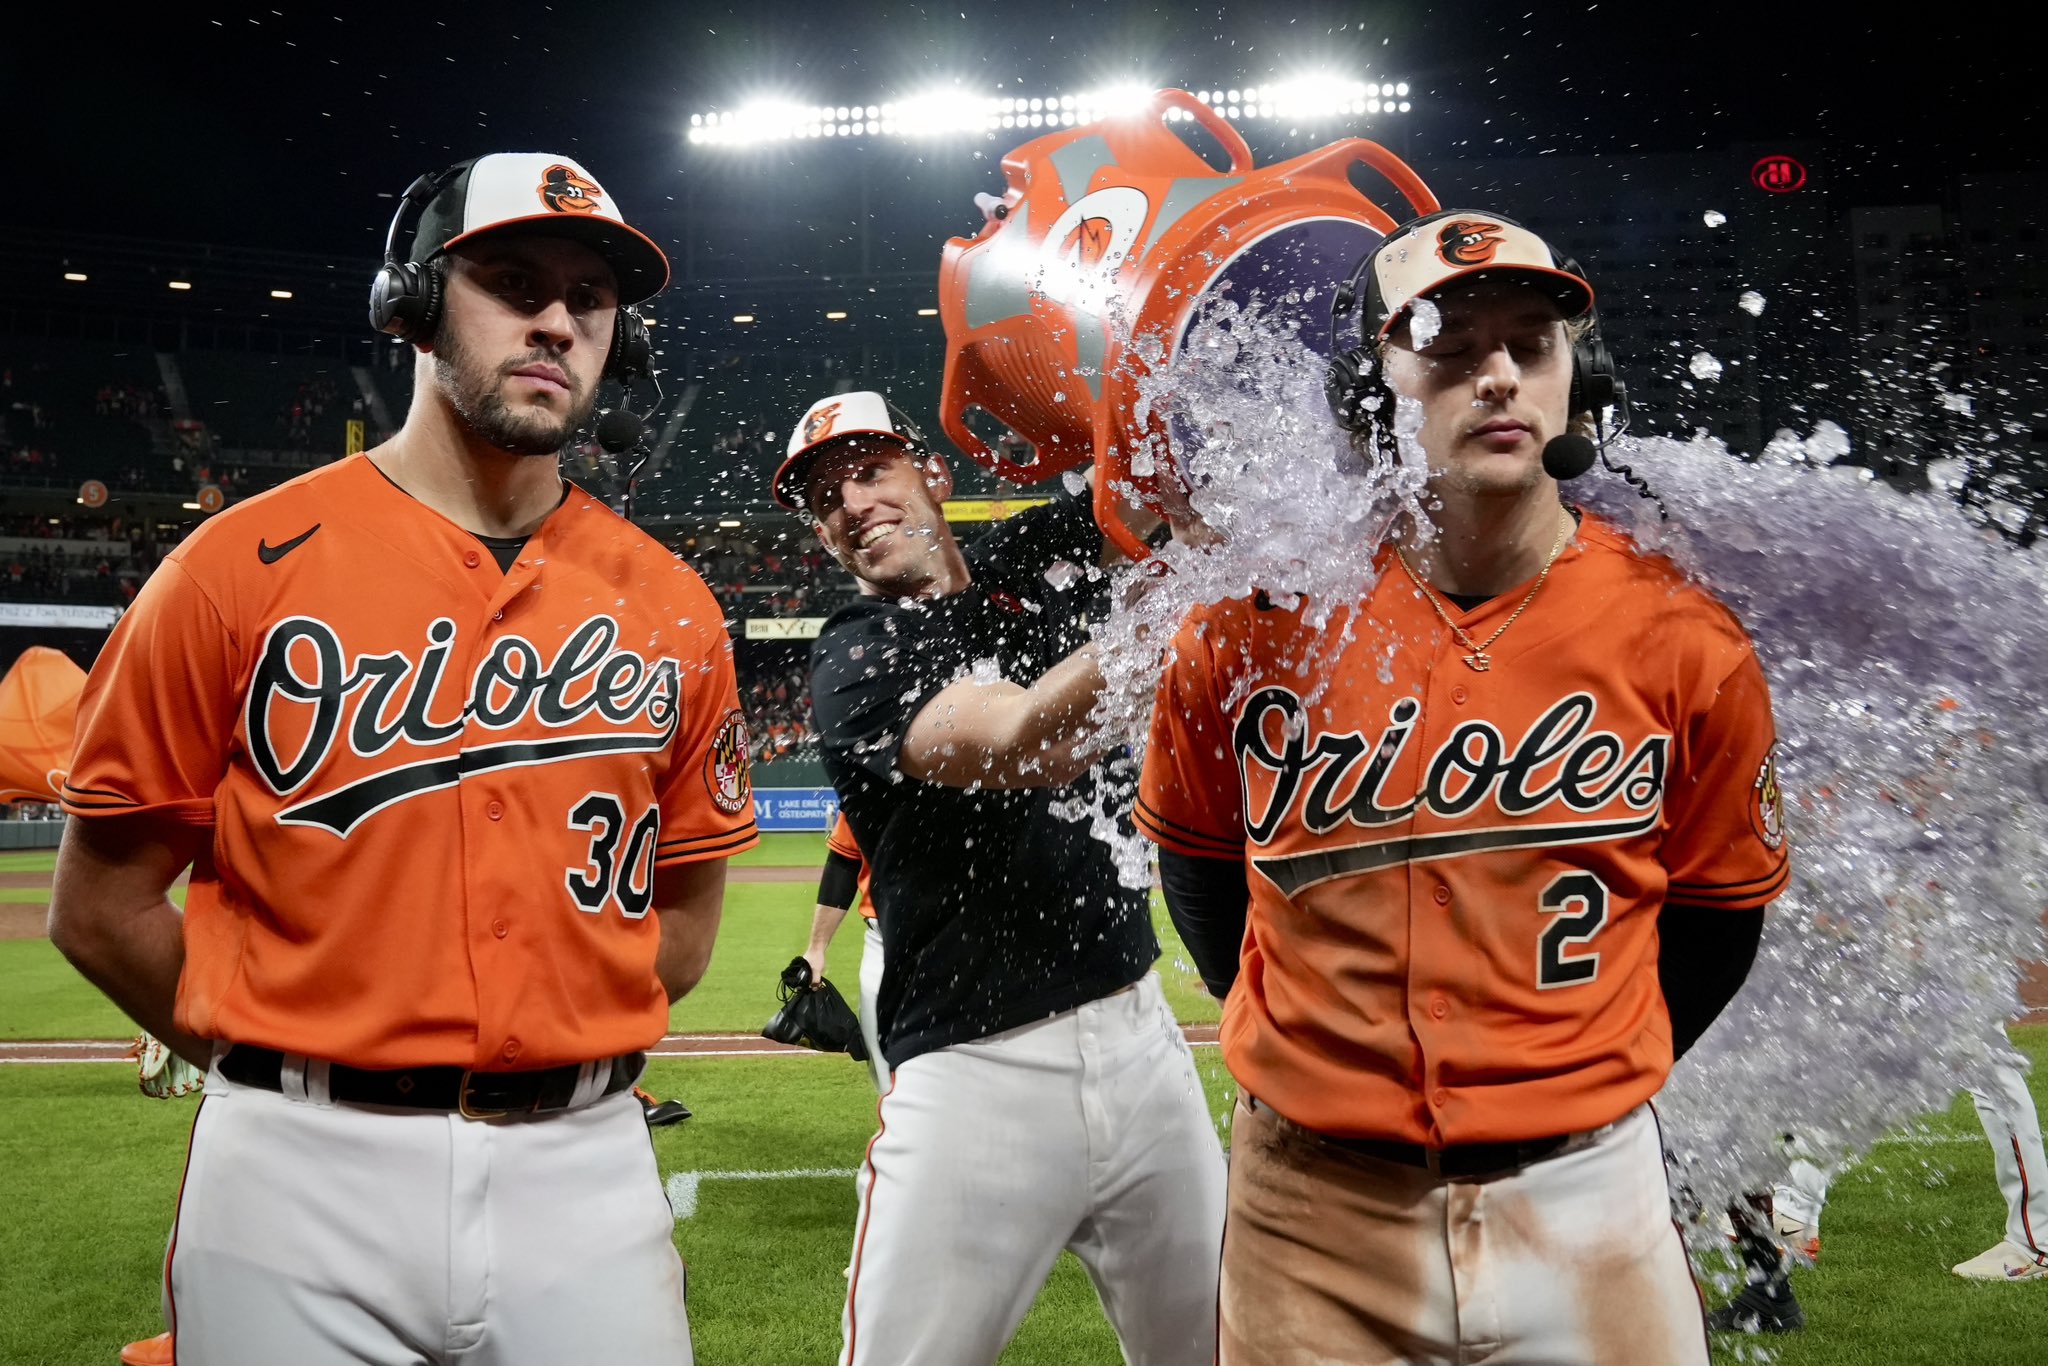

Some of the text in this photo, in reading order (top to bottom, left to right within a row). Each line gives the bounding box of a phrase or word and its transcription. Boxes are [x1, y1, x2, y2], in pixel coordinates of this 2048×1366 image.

[245, 613, 681, 797] Orioles
[1233, 685, 1672, 846] Orioles
[564, 790, 661, 919] 30
[778, 799, 800, 808] LAKE
[802, 799, 819, 808] ERIE
[1536, 869, 1610, 990] 2
